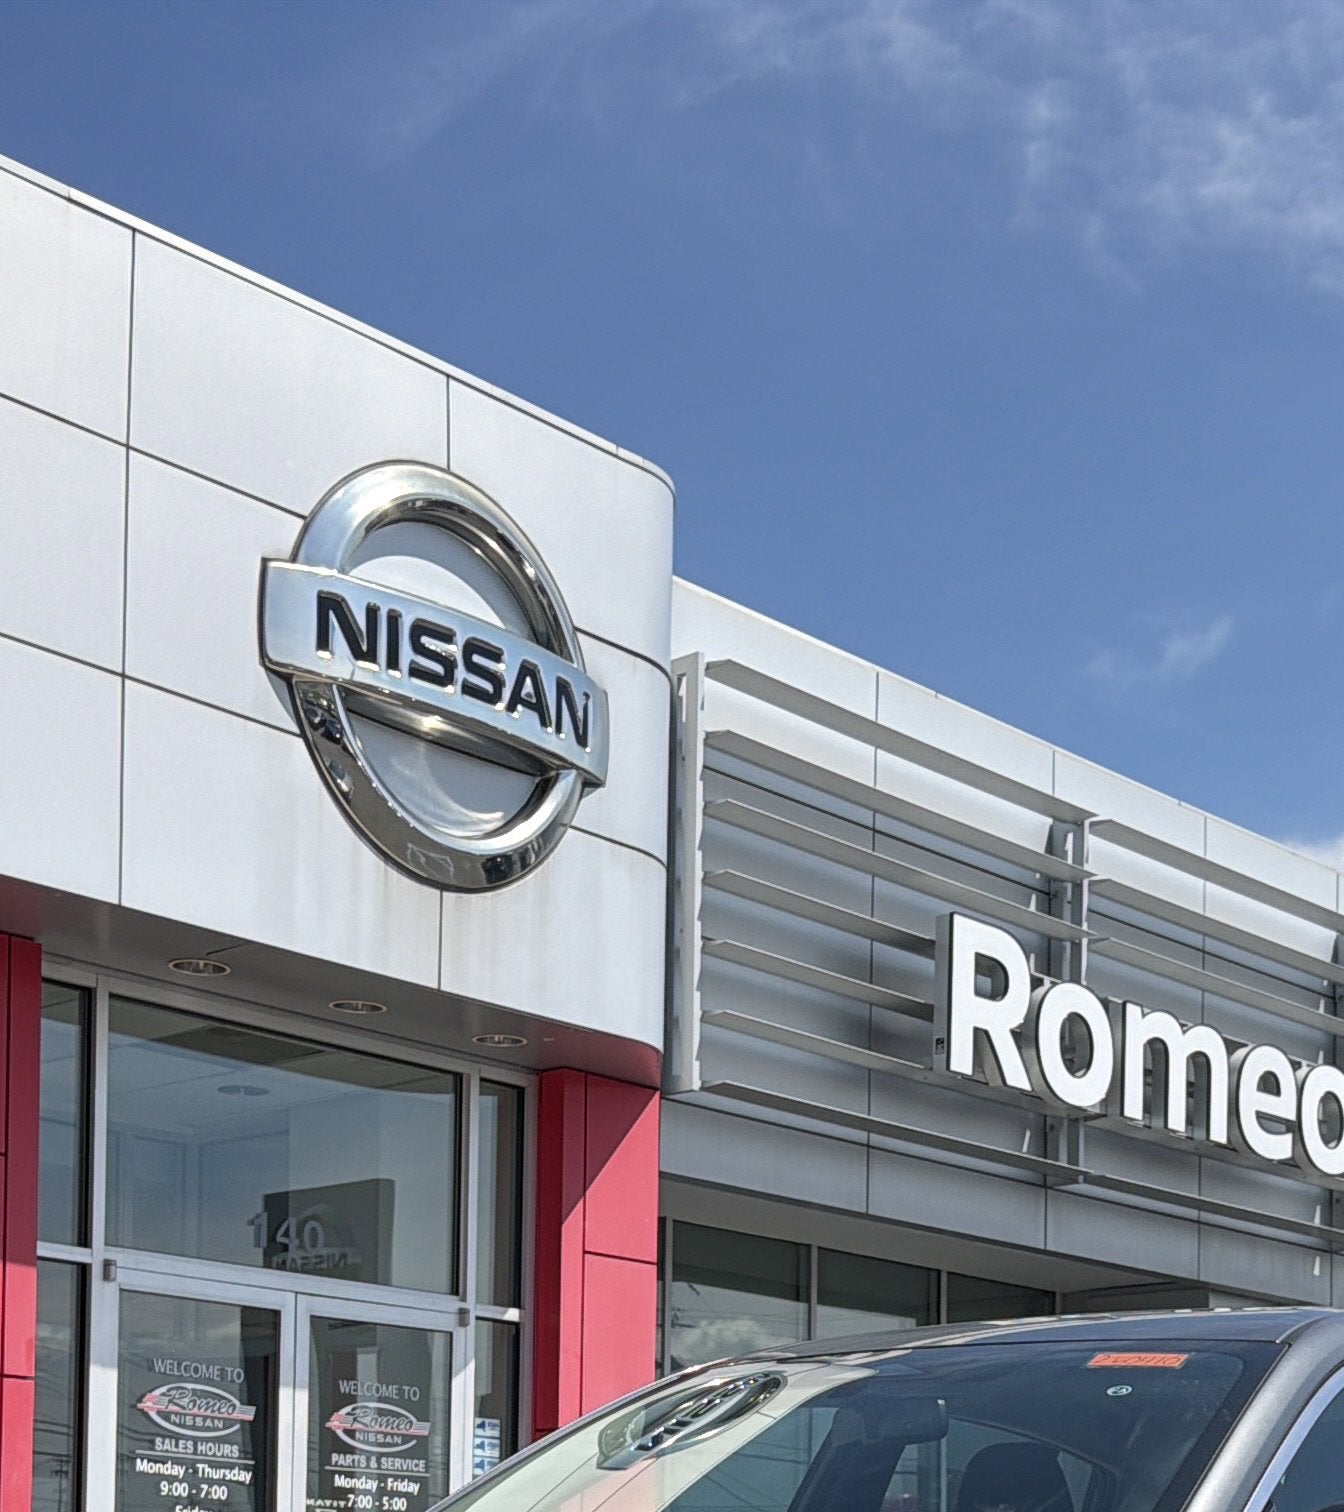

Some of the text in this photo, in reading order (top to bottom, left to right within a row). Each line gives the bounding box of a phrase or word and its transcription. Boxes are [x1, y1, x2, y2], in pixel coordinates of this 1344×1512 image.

[315, 589, 592, 753] NISSAN
[153, 1357, 245, 1384] WELCOME TO
[158, 1386, 237, 1415] Romeo
[339, 1379, 420, 1401] WELCOME TO
[170, 1414, 224, 1429] NISSAN
[345, 1405, 413, 1432] Romeo
[155, 1437, 240, 1458] SALES HOURS
[355, 1431, 402, 1445] NISSAN
[135, 1457, 186, 1479] Monday
[196, 1463, 253, 1485] Thursday
[331, 1453, 426, 1472] PARTS & SERVICE
[159, 1481, 189, 1498] 9:00
[199, 1484, 228, 1501] 7:00
[334, 1474, 379, 1493] Monday
[387, 1478, 420, 1496] Friday
[347, 1494, 373, 1510] 7:00
[382, 1496, 407, 1512] 5:00
